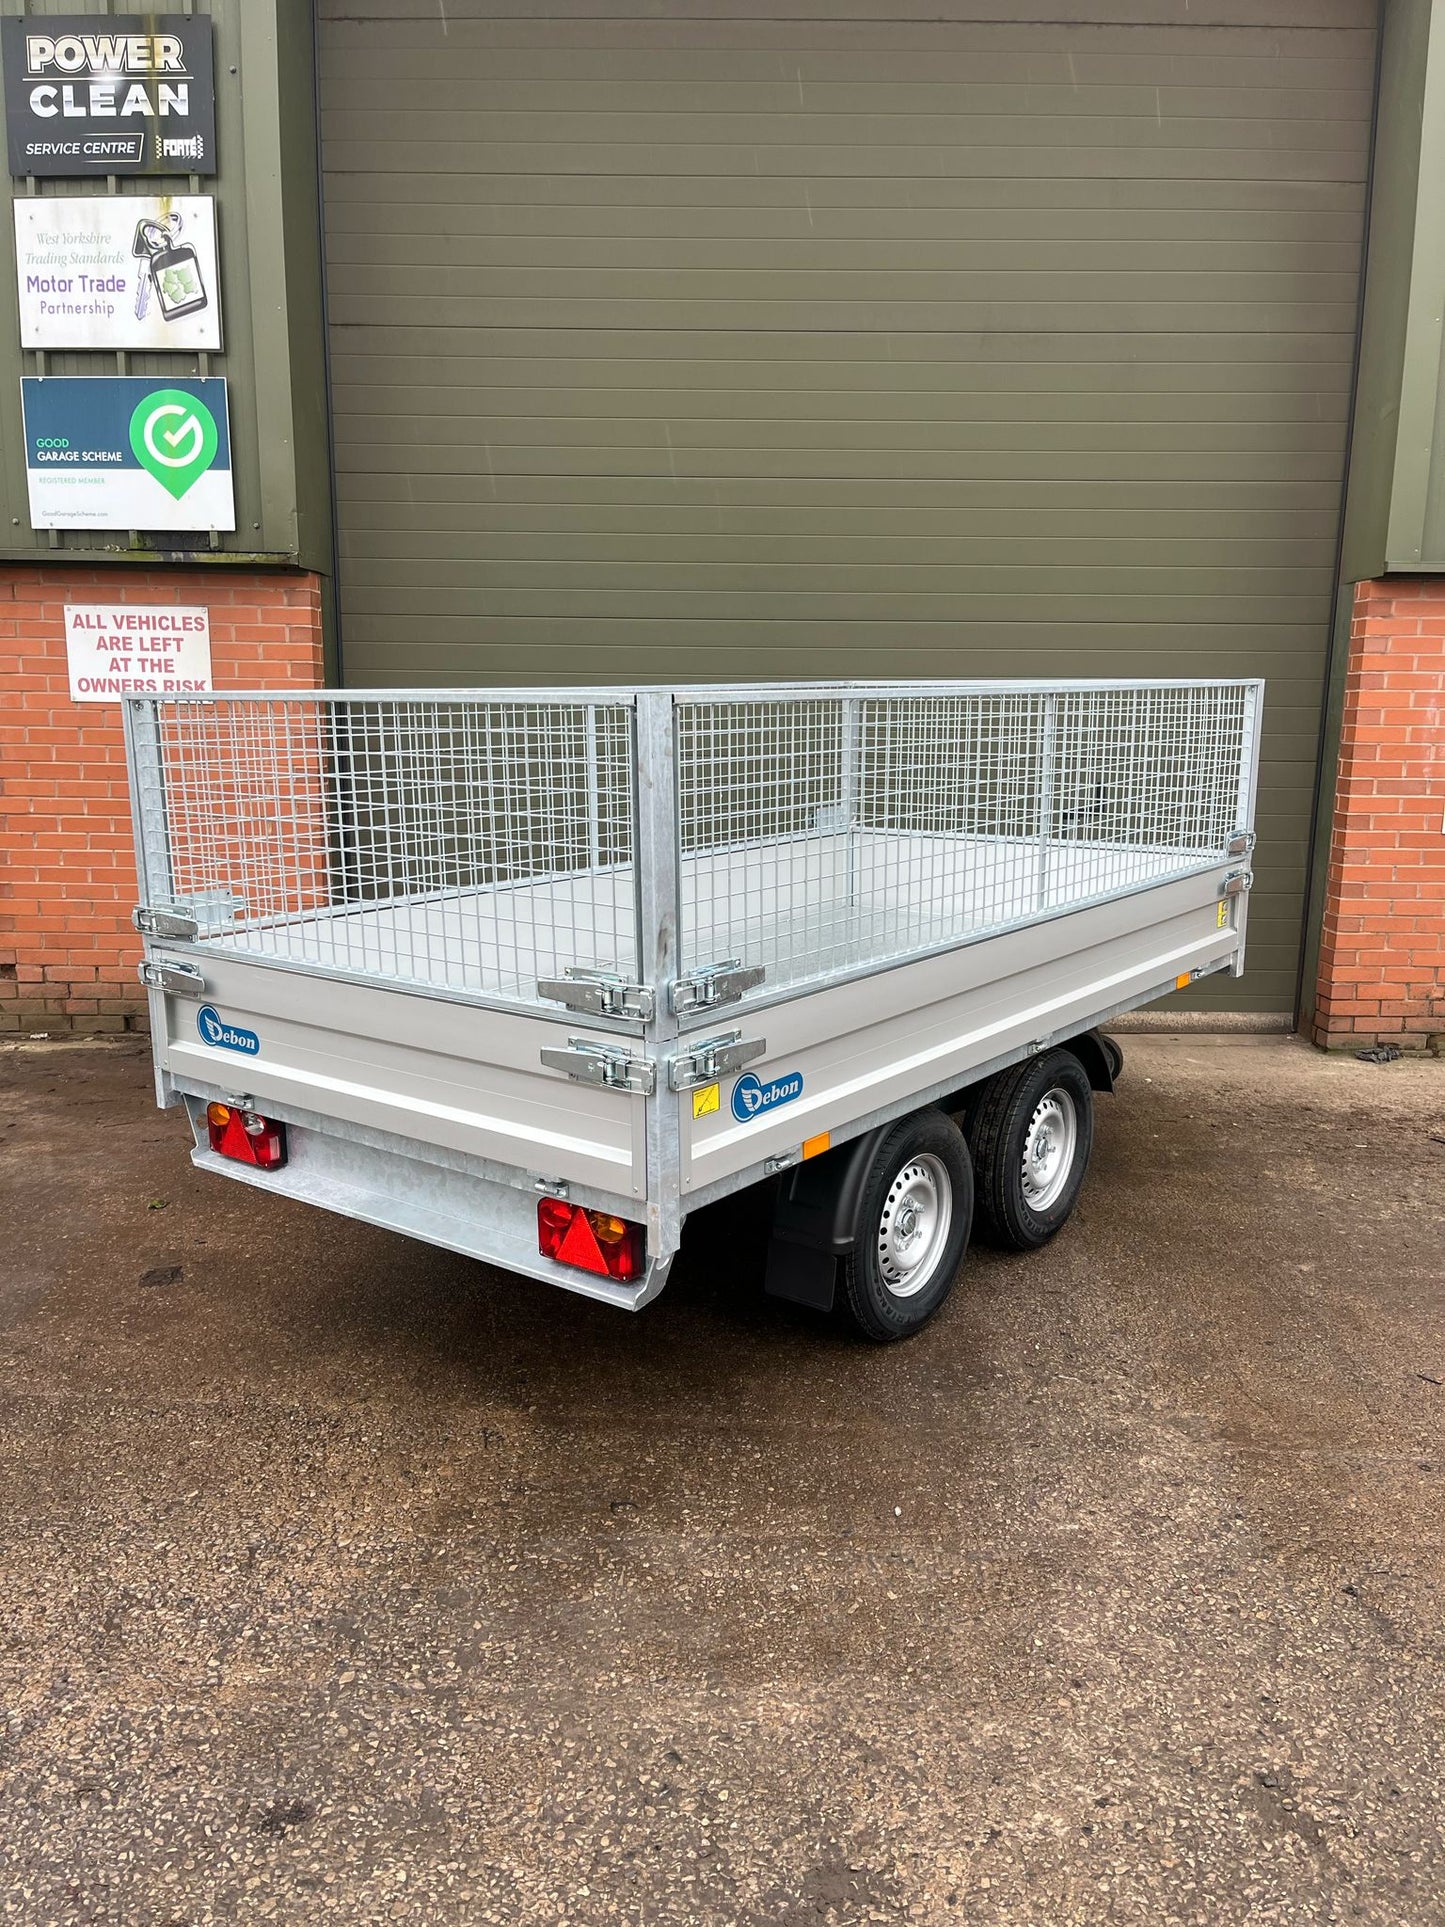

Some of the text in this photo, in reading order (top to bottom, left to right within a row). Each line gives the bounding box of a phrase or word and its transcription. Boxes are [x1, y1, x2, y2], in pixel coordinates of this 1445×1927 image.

[26, 35, 187, 73] POWER
[29, 84, 189, 118] CLEAN
[25, 142, 136, 155] SERVICE CENTRE
[37, 232, 112, 245] West Yorkshire
[25, 251, 125, 268] Trading Standards
[27, 275, 126, 293] Motor Trade
[40, 301, 115, 318] Partnership
[36, 438, 69, 448] GOOD
[37, 451, 122, 462] GARAGE SCHEME
[42, 510, 108, 518] GoodGarageScheme.com
[72, 614, 205, 632] ALL VEHICLES
[96, 636, 184, 652] ARE LEFT
[109, 657, 175, 673] AT THE
[77, 677, 207, 693] OWNERS RISK
[205, 1015, 256, 1050] Debon
[741, 1079, 799, 1112] Debon
